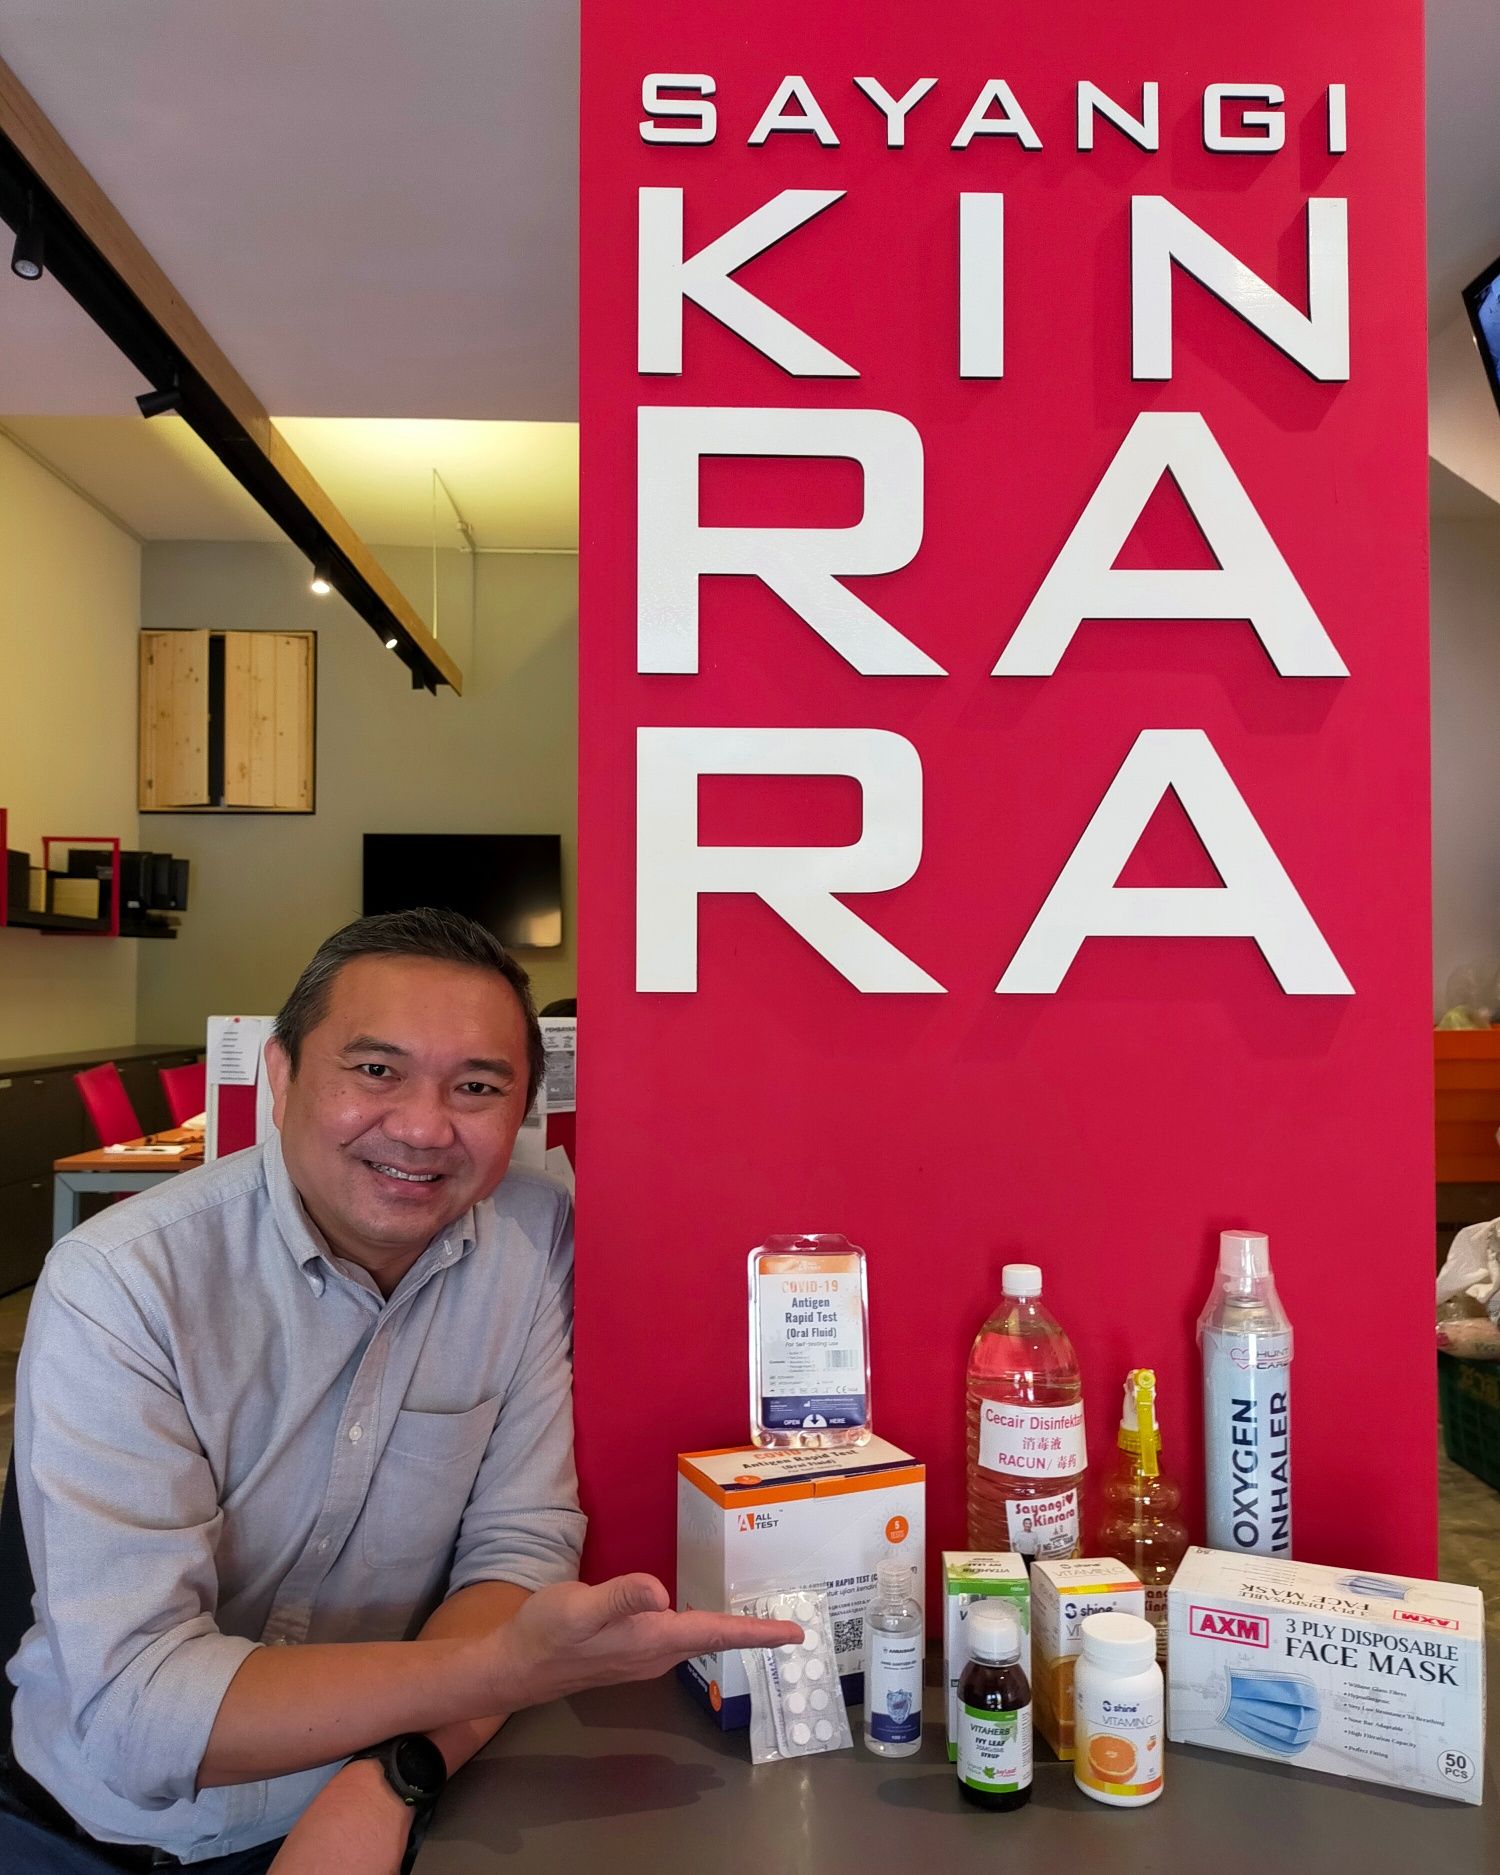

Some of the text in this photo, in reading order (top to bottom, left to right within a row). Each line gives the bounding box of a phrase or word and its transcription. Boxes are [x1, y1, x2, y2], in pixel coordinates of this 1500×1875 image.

[638, 73, 1347, 152] SAYANGI
[637, 186, 1350, 382] KIN
[636, 406, 1351, 678] RA
[635, 727, 1357, 995] RA
[782, 1280, 838, 1294] COVID-19
[792, 1297, 830, 1310] Antigen
[785, 1311, 838, 1325] Rapid Test
[787, 1327, 837, 1340] (Oral Fluid)
[985, 1408, 1025, 1428] Cecair
[1022, 1436, 1062, 1451] 消毒液
[743, 1459, 791, 1469] Antigen
[794, 1453, 829, 1462] Rapid
[831, 1449, 858, 1457] Test
[1231, 1398, 1259, 1548] OXYGEN
[1270, 1391, 1289, 1552] INHALER
[1015, 1496, 1066, 1514] Sayangi
[755, 1513, 772, 1521] ALL
[1033, 1509, 1075, 1527] Kinrara
[756, 1520, 779, 1530] TEST
[894, 1521, 900, 1530] 5
[835, 1577, 855, 1587] RAPID
[856, 1575, 870, 1584] TEST
[1240, 1591, 1324, 1610] DISPOSABLE
[1241, 1583, 1370, 1611] FACE MASK
[1080, 1603, 1114, 1617] shine
[1330, 1606, 1355, 1615] PLY
[1401, 1613, 1449, 1626] AXM
[1200, 1614, 1260, 1641] AXM
[1285, 1618, 1459, 1662] 3 PLY DISPOSABLE
[1285, 1636, 1459, 1687] FACE MASK
[1113, 1704, 1138, 1713] shine
[1102, 1714, 1145, 1728] VITAMIN
[970, 1722, 1011, 1736] VITAHERB
[988, 1739, 1006, 1747] LEAF
[1445, 1753, 1467, 1769] 50
[1445, 1767, 1469, 1779] PCS
